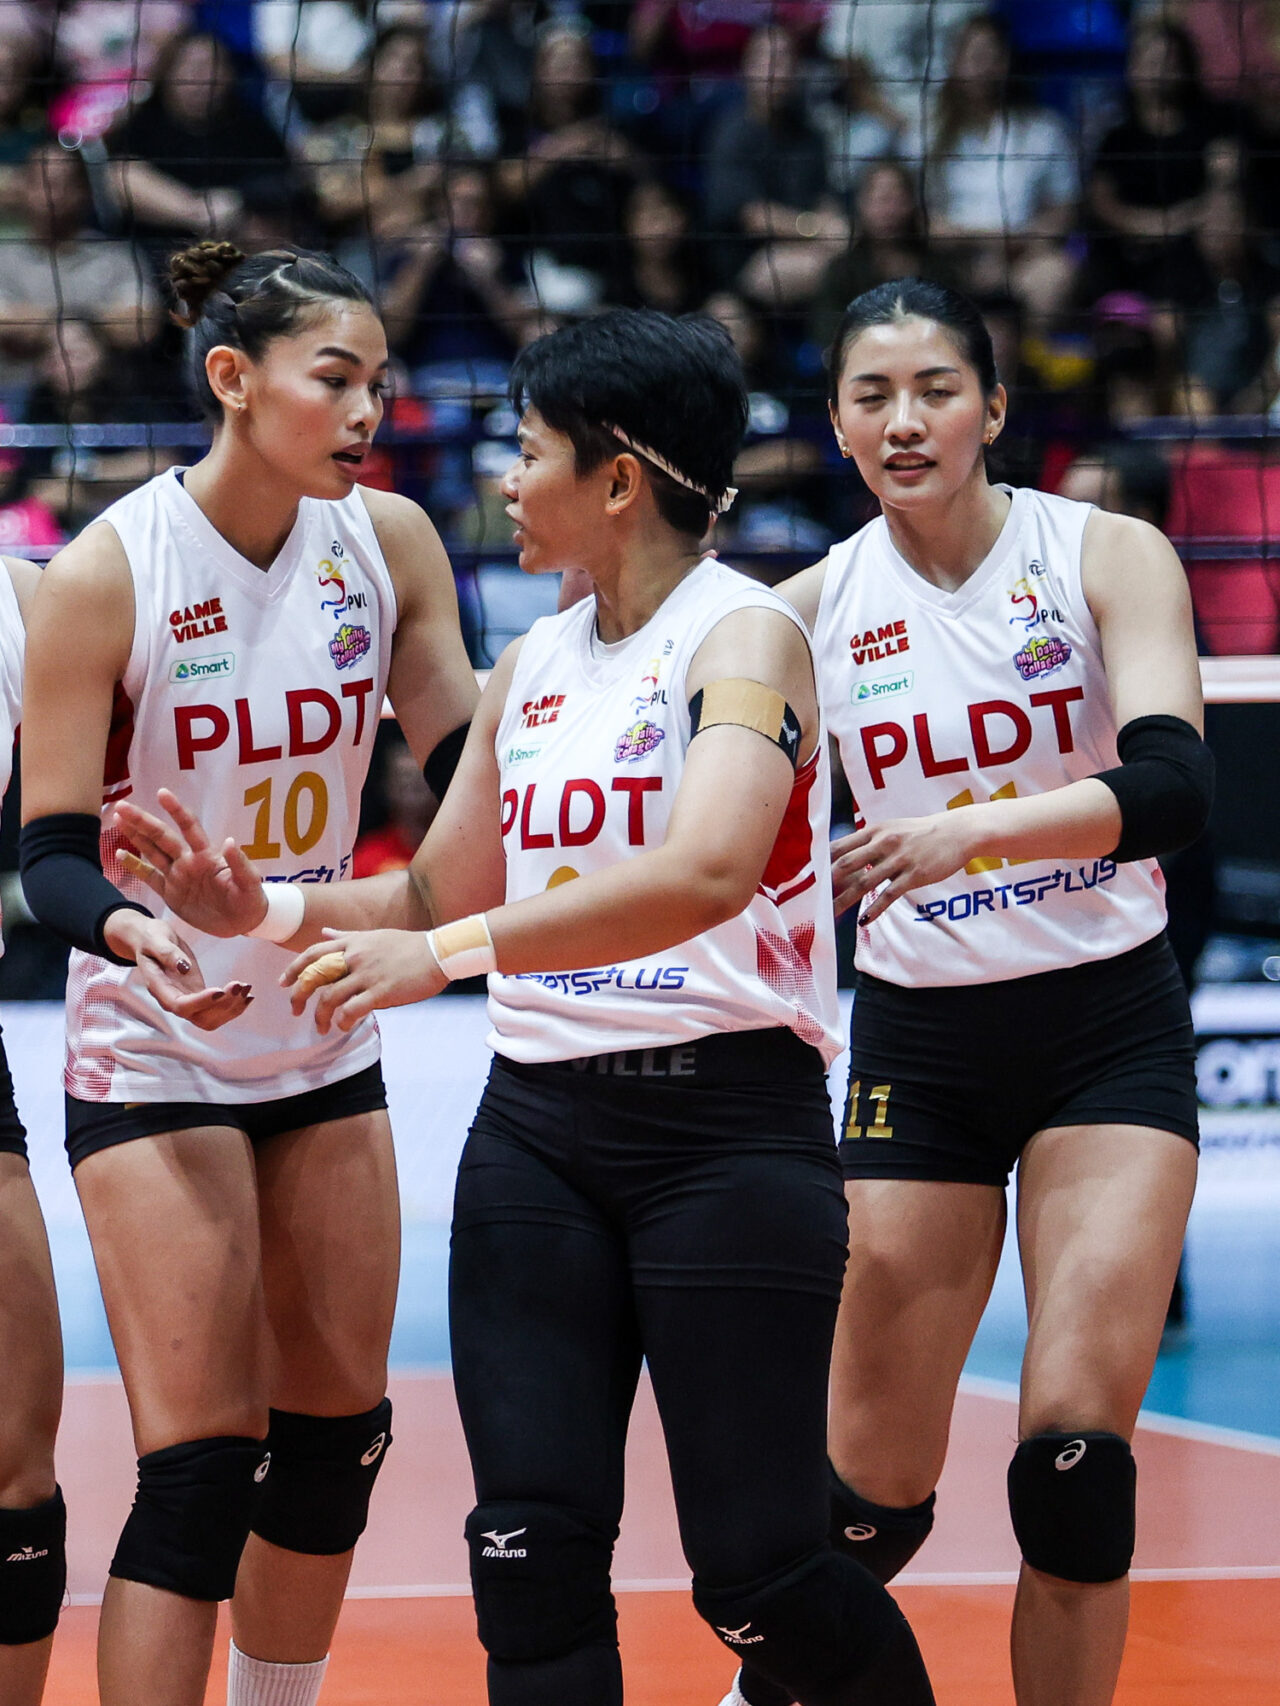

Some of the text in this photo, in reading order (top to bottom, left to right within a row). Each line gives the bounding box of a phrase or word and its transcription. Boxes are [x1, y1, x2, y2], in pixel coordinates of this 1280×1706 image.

[169, 597, 223, 627] GAME
[172, 616, 229, 644] VILLE
[850, 620, 907, 650] GAME
[852, 636, 910, 666] VILLE
[190, 658, 230, 676] Smart
[871, 677, 909, 696] Smart
[173, 677, 374, 771] PLDT
[859, 686, 1085, 791] PLDT
[240, 771, 329, 861] 10
[845, 1080, 894, 1139] 11
[481, 1545, 528, 1558] MIZUNO
